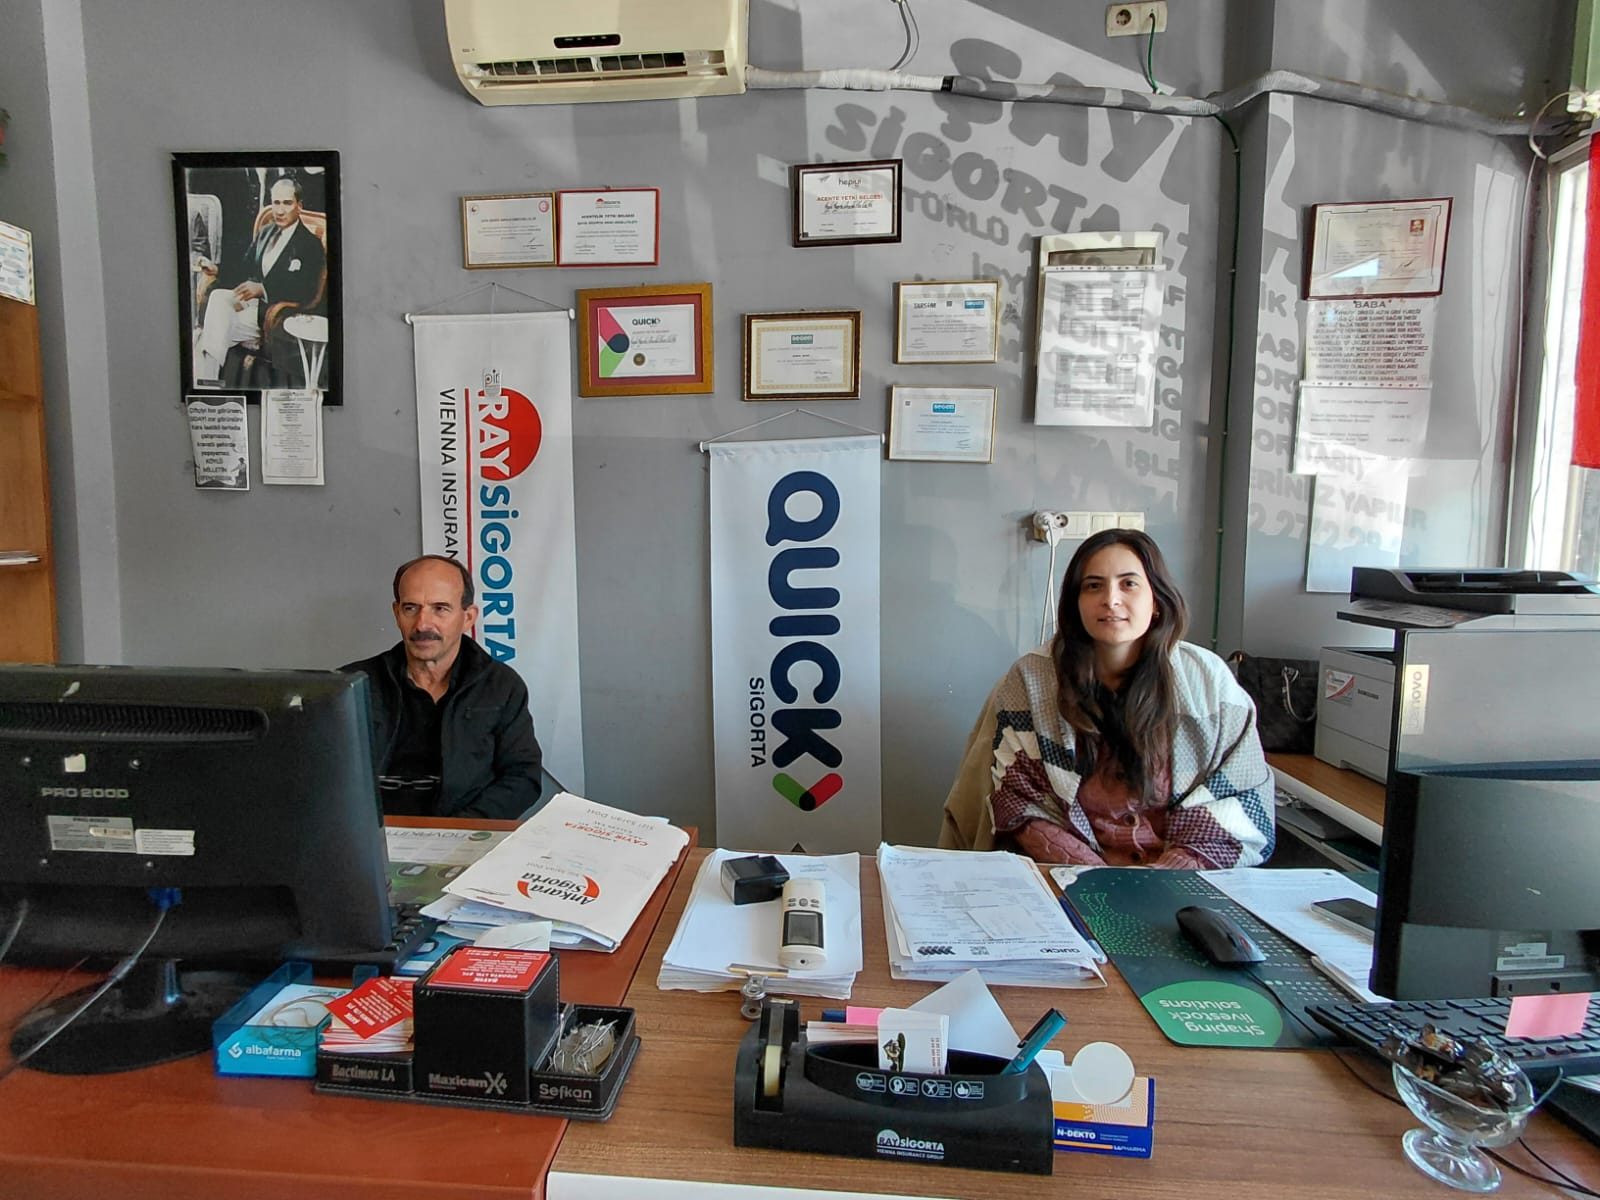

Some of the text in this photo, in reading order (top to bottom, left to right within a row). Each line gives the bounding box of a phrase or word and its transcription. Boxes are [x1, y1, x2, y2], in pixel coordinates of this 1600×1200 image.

[440, 389, 457, 466] VIENNA
[477, 393, 511, 479] RAY
[765, 470, 843, 769] QUICK
[41, 787, 78, 798] PRO
[520, 872, 586, 894] Sigorta
[529, 884, 595, 906] Ankara
[1159, 999, 1241, 1010] solutions
[1168, 1011, 1255, 1024] livestock
[1184, 1021, 1265, 1036] Shaping
[245, 1044, 302, 1057] albafarma
[331, 1063, 396, 1082] Bactimox LA
[538, 1083, 593, 1100] Sefkan
[1056, 1128, 1096, 1140] N-DEKTO
